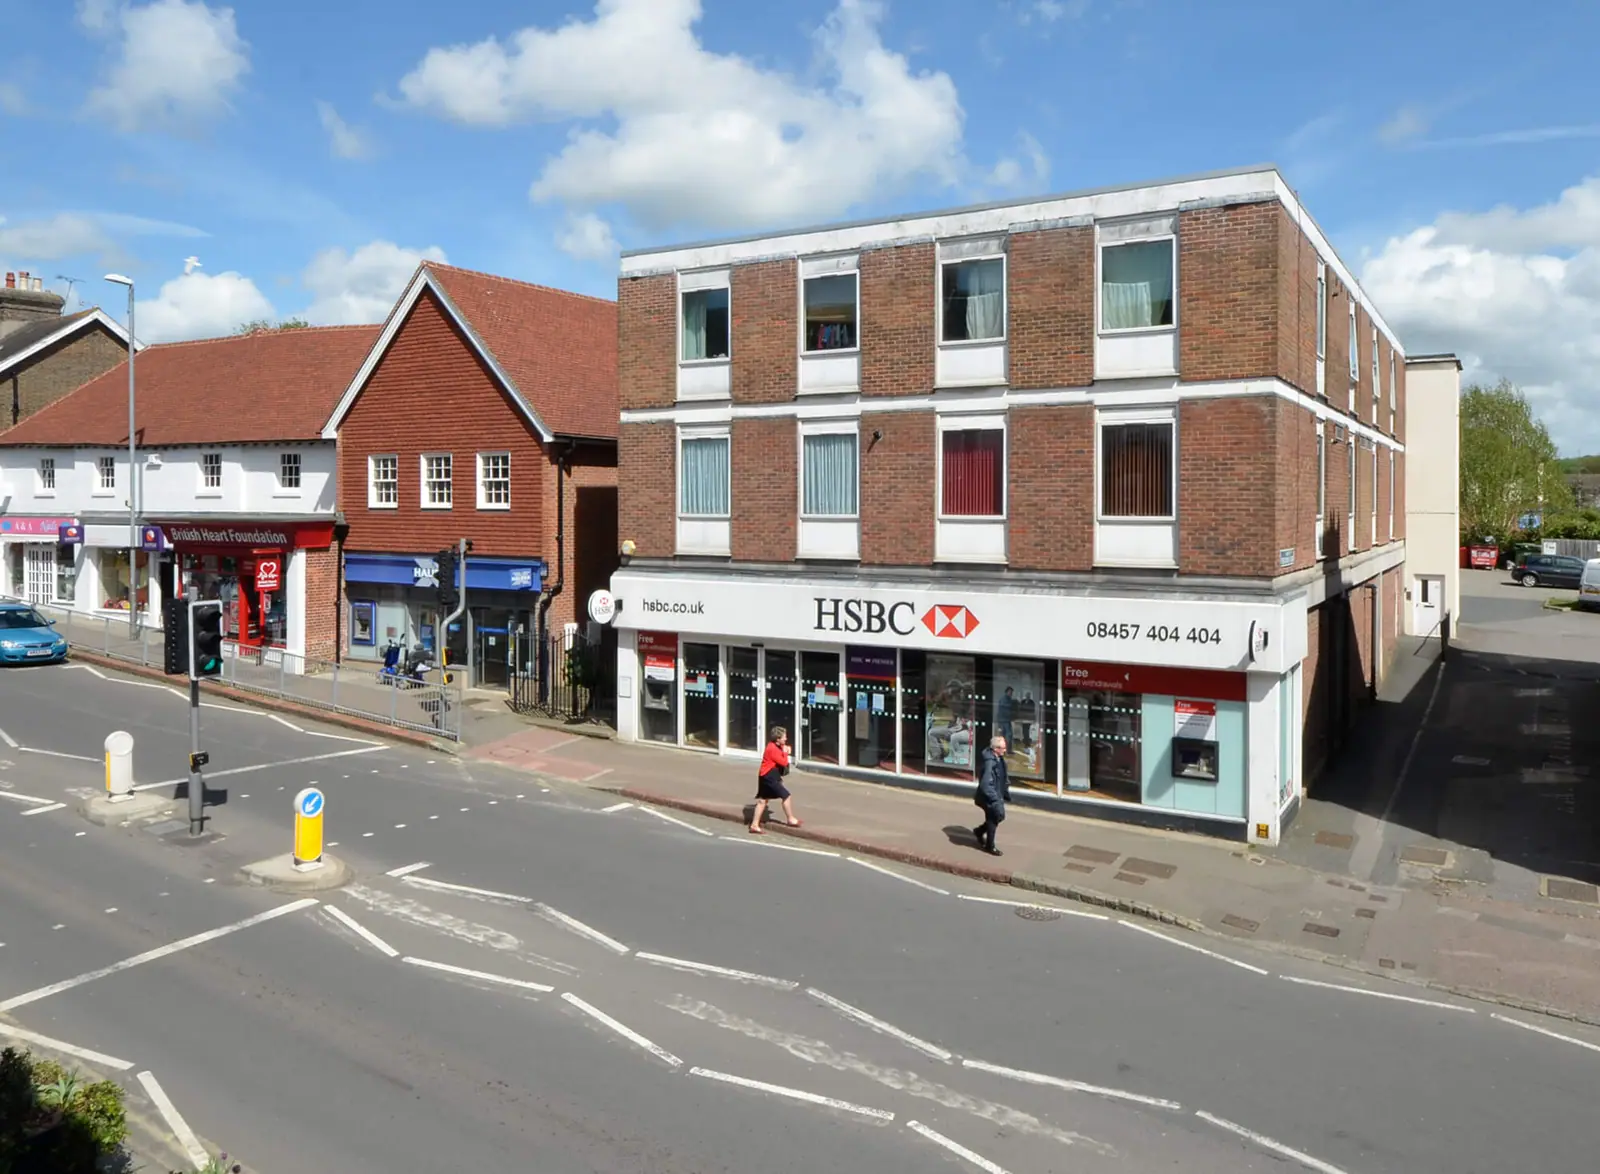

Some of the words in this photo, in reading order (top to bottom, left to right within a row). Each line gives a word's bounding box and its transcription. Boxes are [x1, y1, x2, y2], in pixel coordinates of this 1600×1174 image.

[170, 527, 201, 541] British
[200, 528, 229, 542] Heart
[227, 529, 288, 544] Foundation
[643, 599, 704, 614] hsbc.co.uk
[813, 597, 915, 636] HSBC
[638, 634, 654, 644] Free
[1087, 622, 1140, 640] 08457
[1146, 625, 1180, 643] 404
[1186, 627, 1221, 645] 404
[1065, 666, 1089, 678] Free
